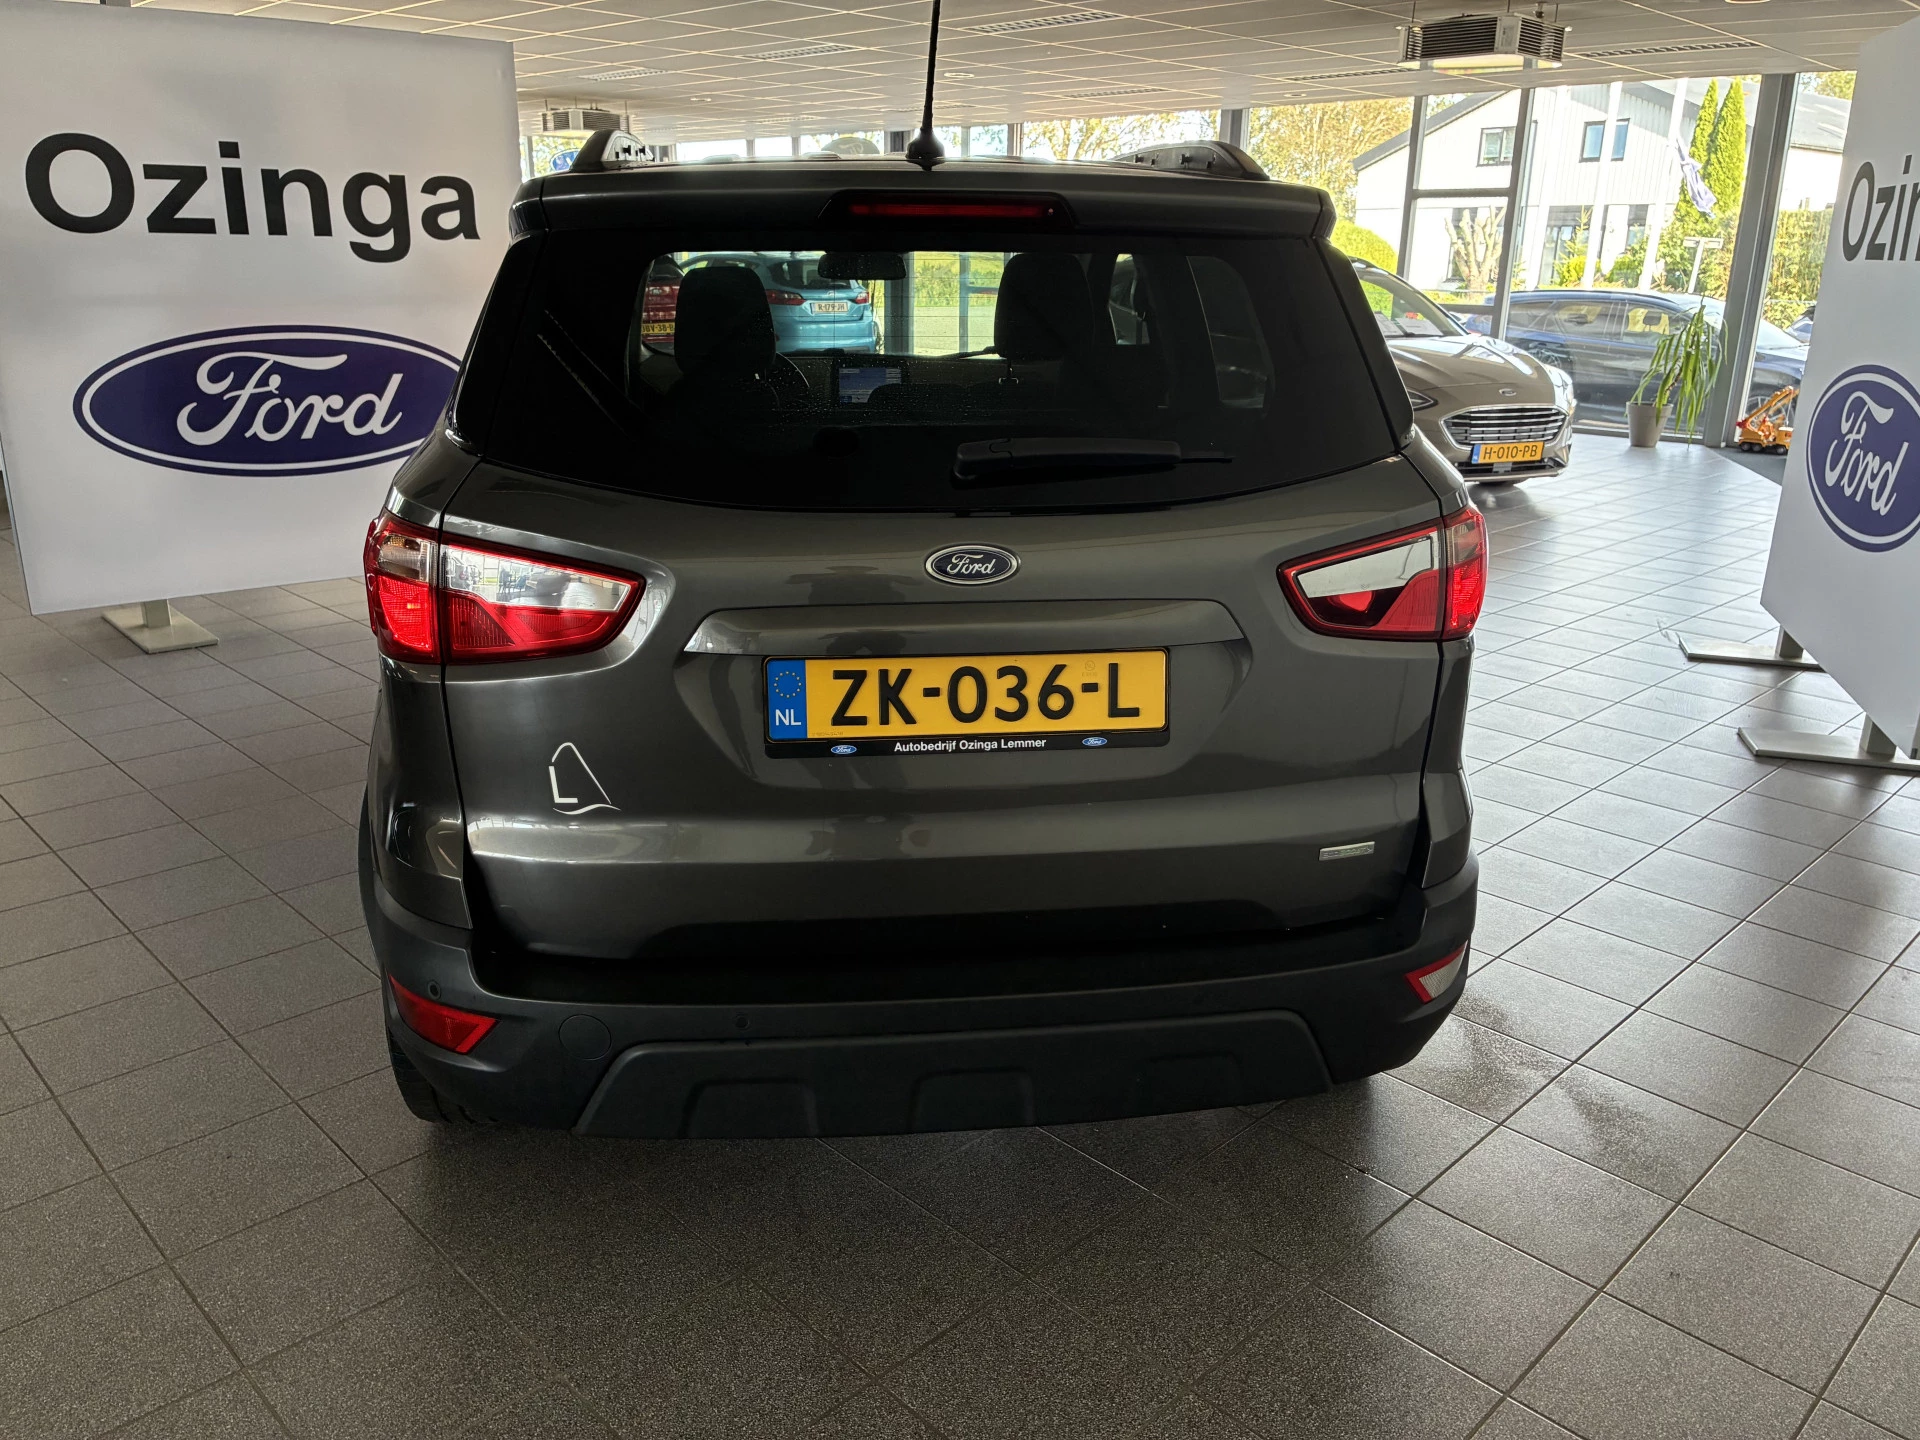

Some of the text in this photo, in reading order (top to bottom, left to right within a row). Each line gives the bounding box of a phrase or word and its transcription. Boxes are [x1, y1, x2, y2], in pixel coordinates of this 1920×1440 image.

[25, 132, 481, 263] Ozinga
[176, 351, 404, 446] Ford
[1483, 445, 1538, 460] H-010-PB
[1825, 391, 1909, 516] Ford
[947, 553, 996, 575] Ford
[831, 662, 1140, 727] ZK-036-L
[775, 708, 802, 726] NL
[894, 739, 1047, 753] Autobedrijf Ozinga Lemmer
